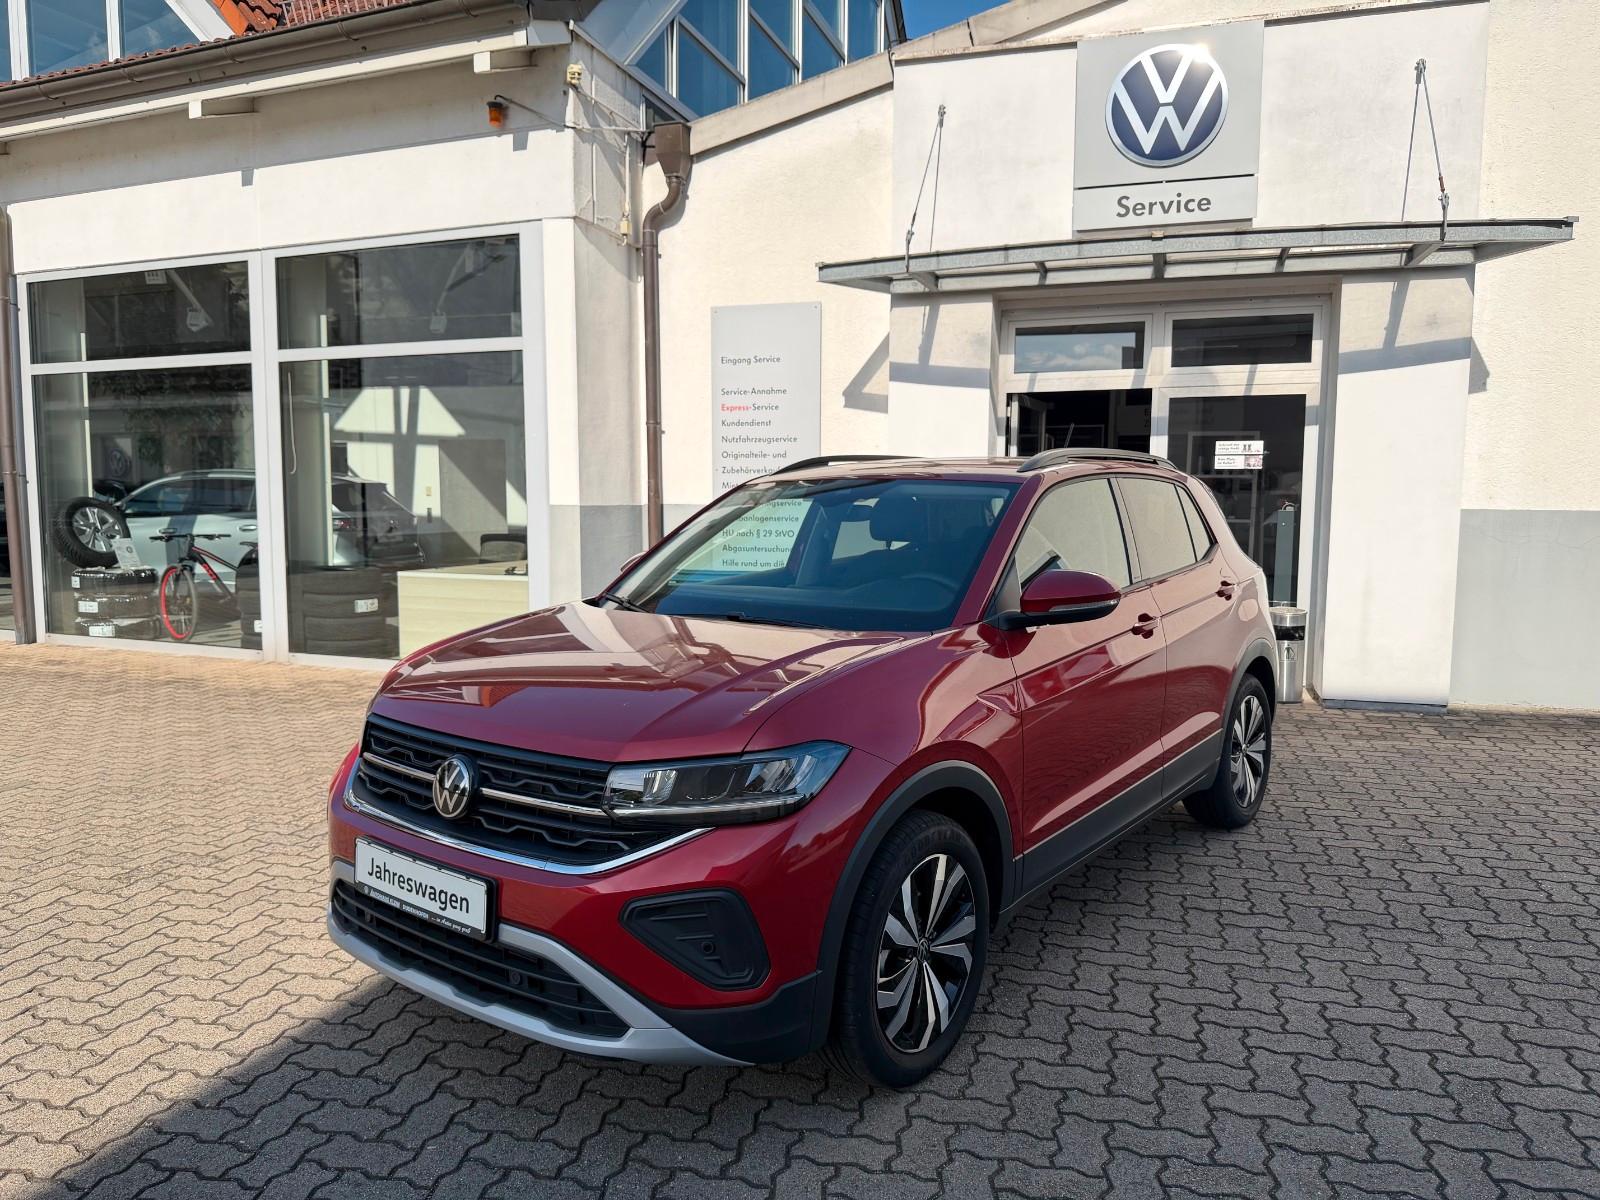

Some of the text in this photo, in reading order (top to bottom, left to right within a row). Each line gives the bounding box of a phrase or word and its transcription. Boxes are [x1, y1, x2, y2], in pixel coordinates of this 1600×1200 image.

[1106, 44, 1228, 167] VW
[1116, 193, 1212, 218] Service
[721, 355, 781, 365] Eingang Service
[721, 387, 787, 396] Service-Annahme
[721, 403, 779, 412] Express-Service
[721, 419, 772, 427] Kundendienst
[721, 435, 798, 444] Nutzfahrzeugservice
[722, 450, 787, 459] Originalteile- und
[737, 529, 754, 537] nach
[775, 529, 795, 538] StVO
[722, 544, 791, 553] Abgasuntersuchun
[722, 559, 739, 567] Hilfe
[741, 559, 758, 567] rund
[368, 857, 470, 914] Jahreswagen
